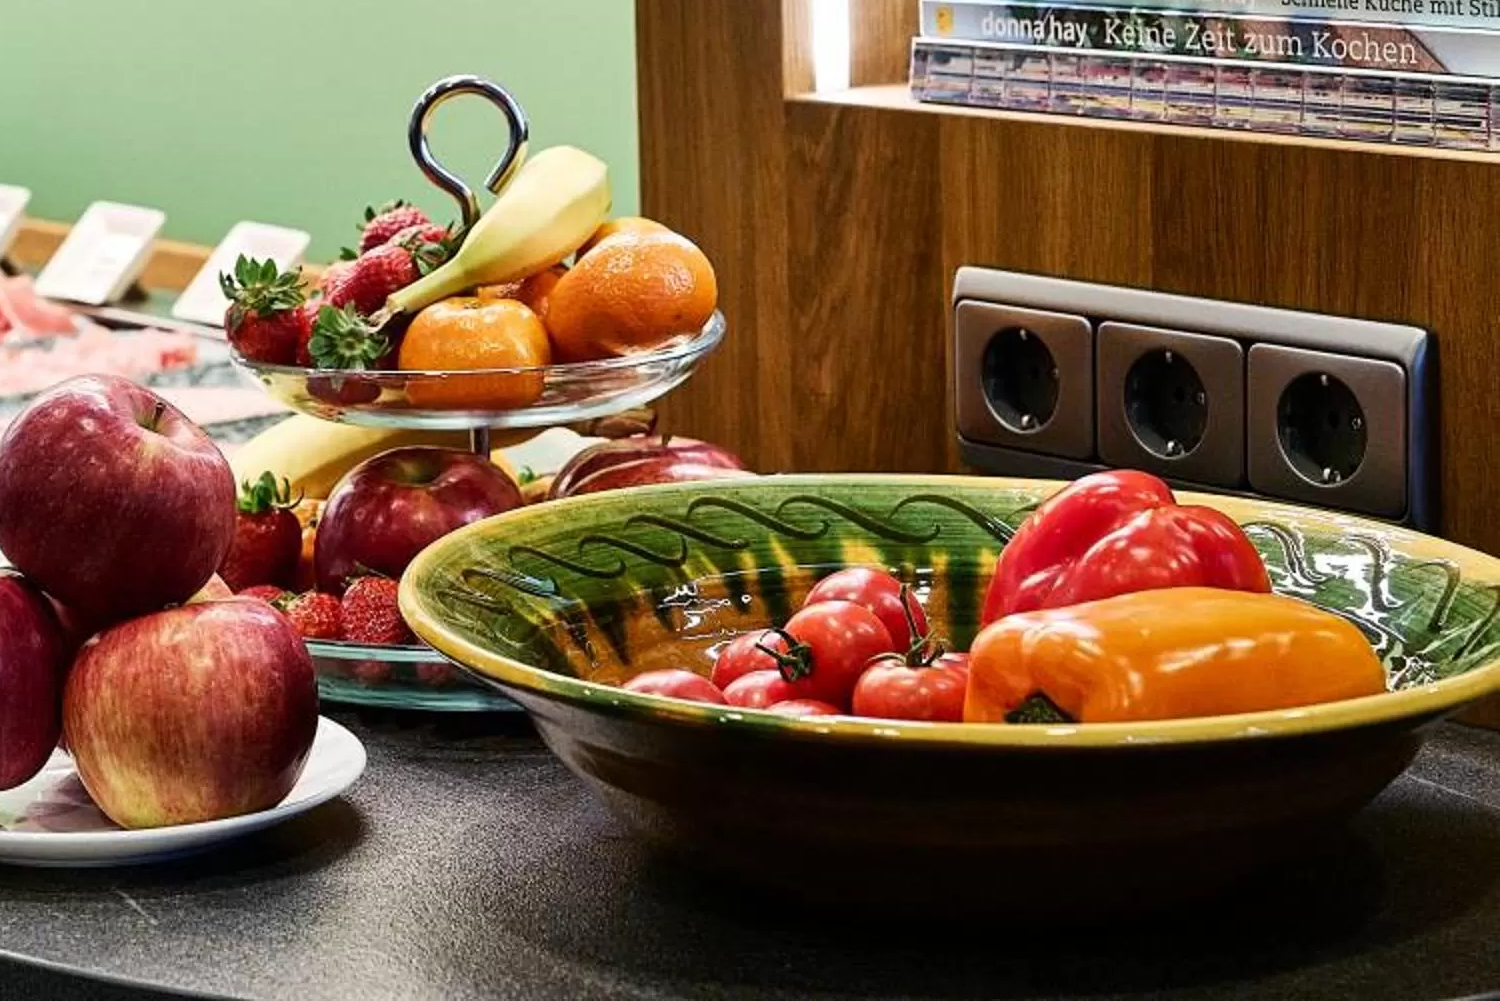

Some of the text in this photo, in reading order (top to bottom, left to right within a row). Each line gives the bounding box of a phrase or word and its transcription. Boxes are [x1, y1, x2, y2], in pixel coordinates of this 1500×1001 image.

[982, 10, 1418, 64] donna hay Keine Zeit zum Kochen
